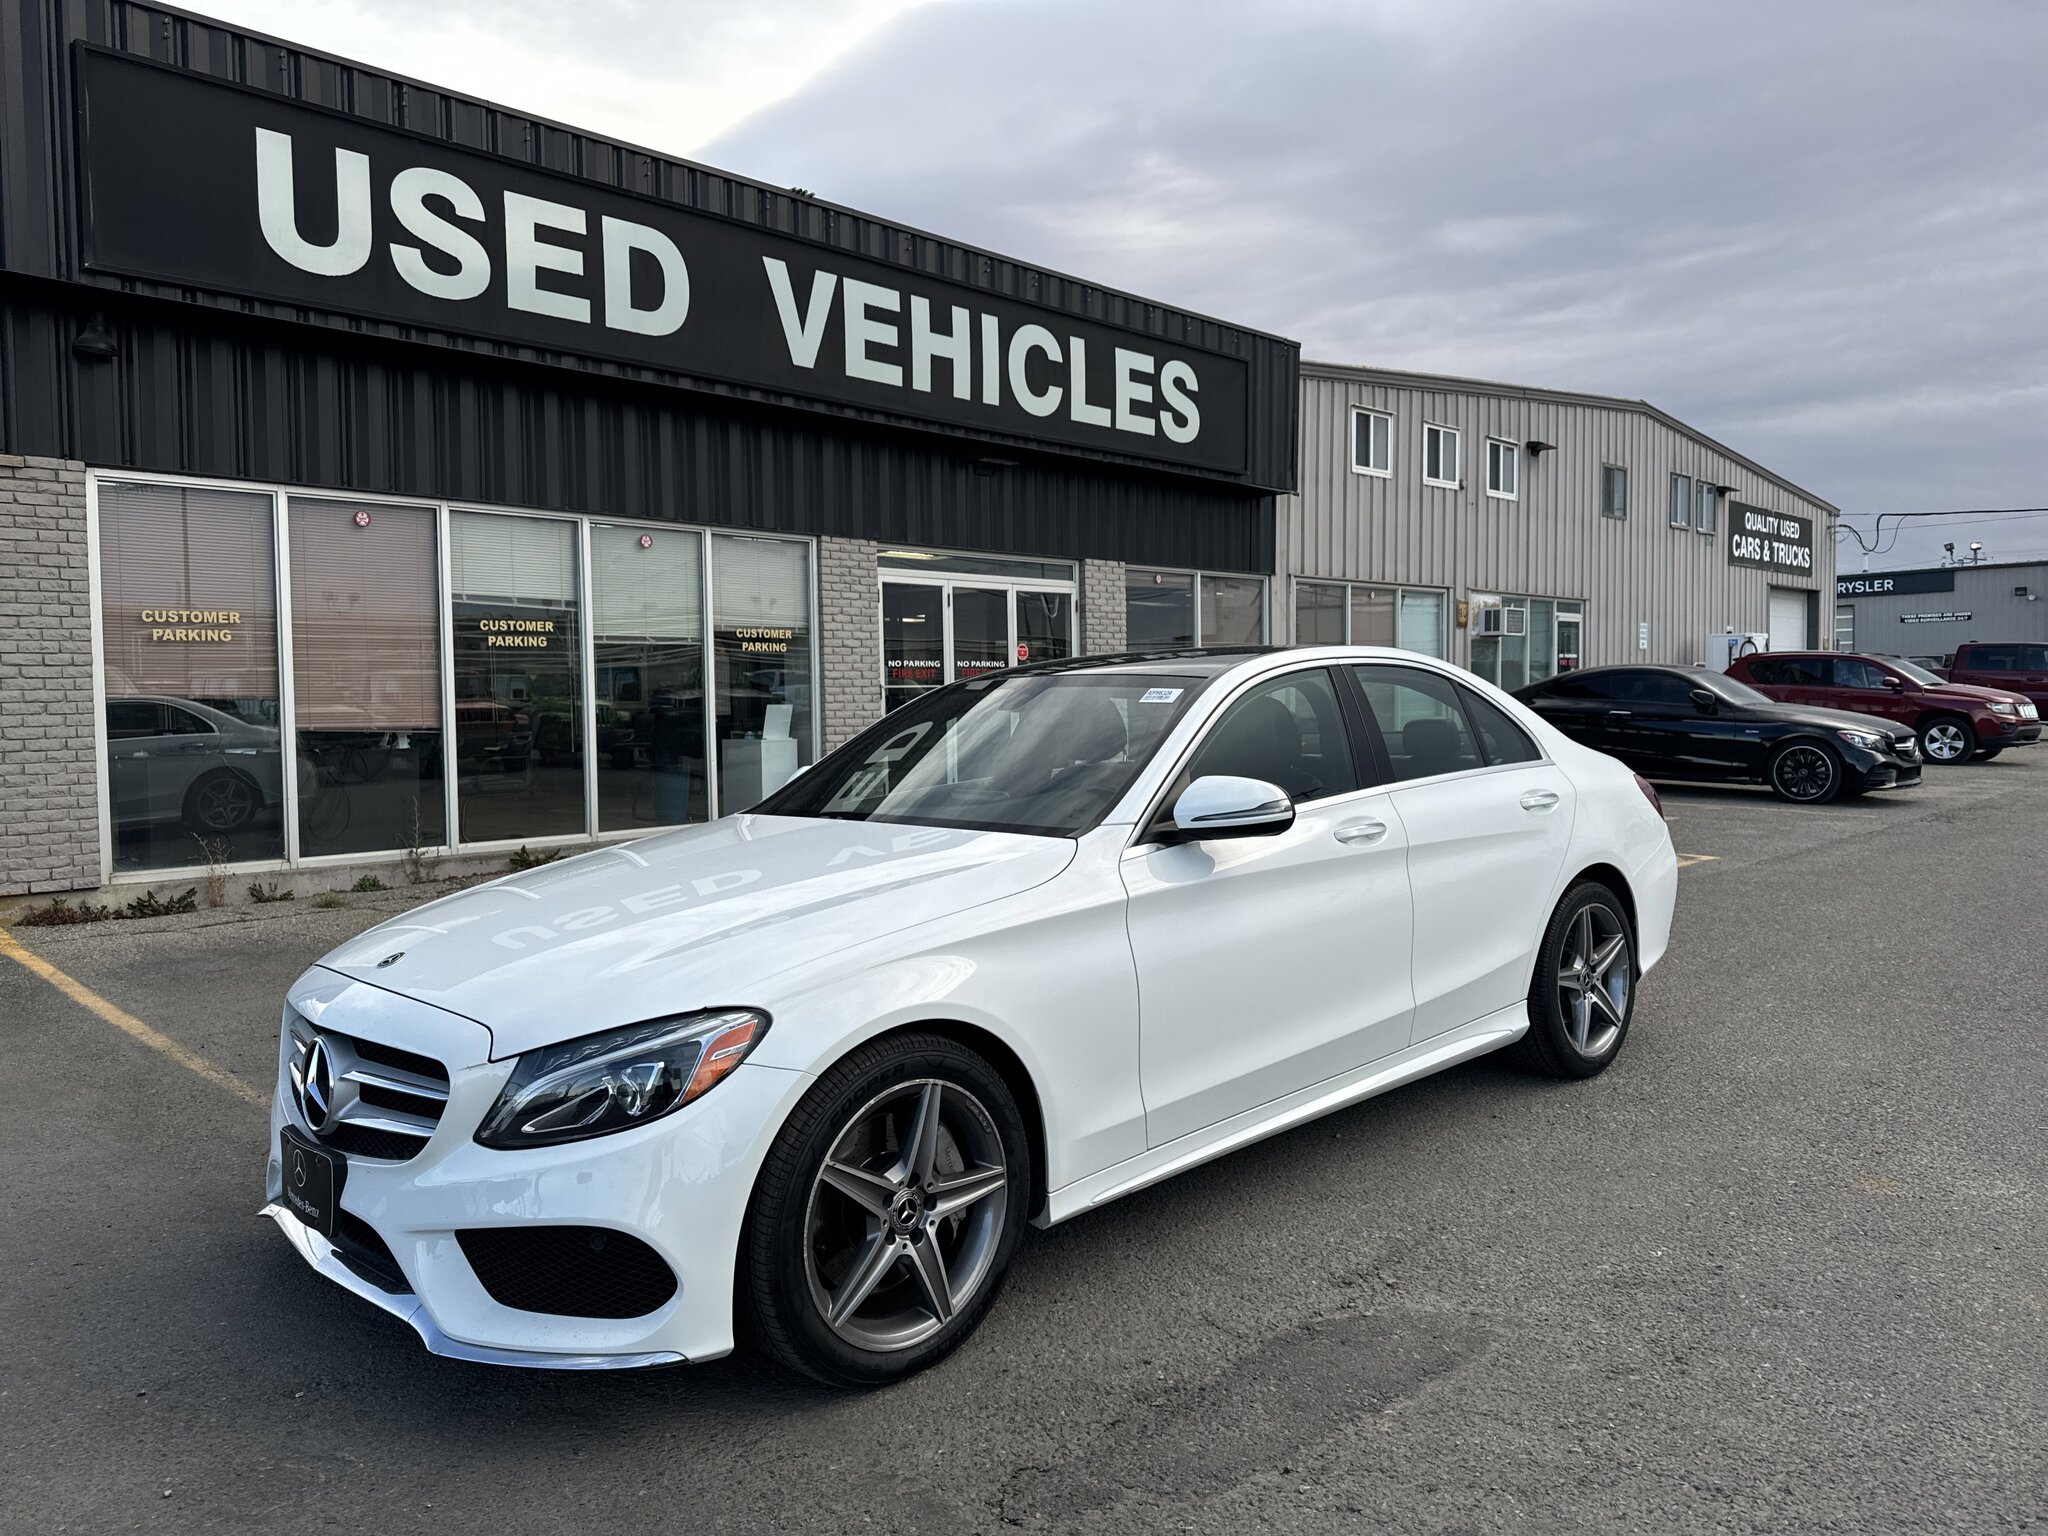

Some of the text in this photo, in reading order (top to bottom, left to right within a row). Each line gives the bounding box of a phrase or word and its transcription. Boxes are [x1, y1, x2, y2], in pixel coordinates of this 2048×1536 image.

[255, 127, 1200, 444] USED VEHICLES
[1745, 512, 1800, 539] QUALITY USED
[1733, 533, 1811, 569] CARS & TRUCKS
[141, 610, 241, 624] CUSTOMER
[479, 619, 555, 633] CUSTOMER
[152, 629, 232, 642] PARKING
[735, 628, 793, 639] CUSTOMER
[487, 635, 548, 648] PARKING
[741, 642, 788, 652] PARKING
[888, 660, 941, 668] NO PARKING
[957, 660, 1006, 668] NO PARKING
[892, 669, 937, 679] FIRE EXIT
[829, 1062, 906, 1128] COOPER
[287, 1185, 320, 1218] Mercedes-Benz
